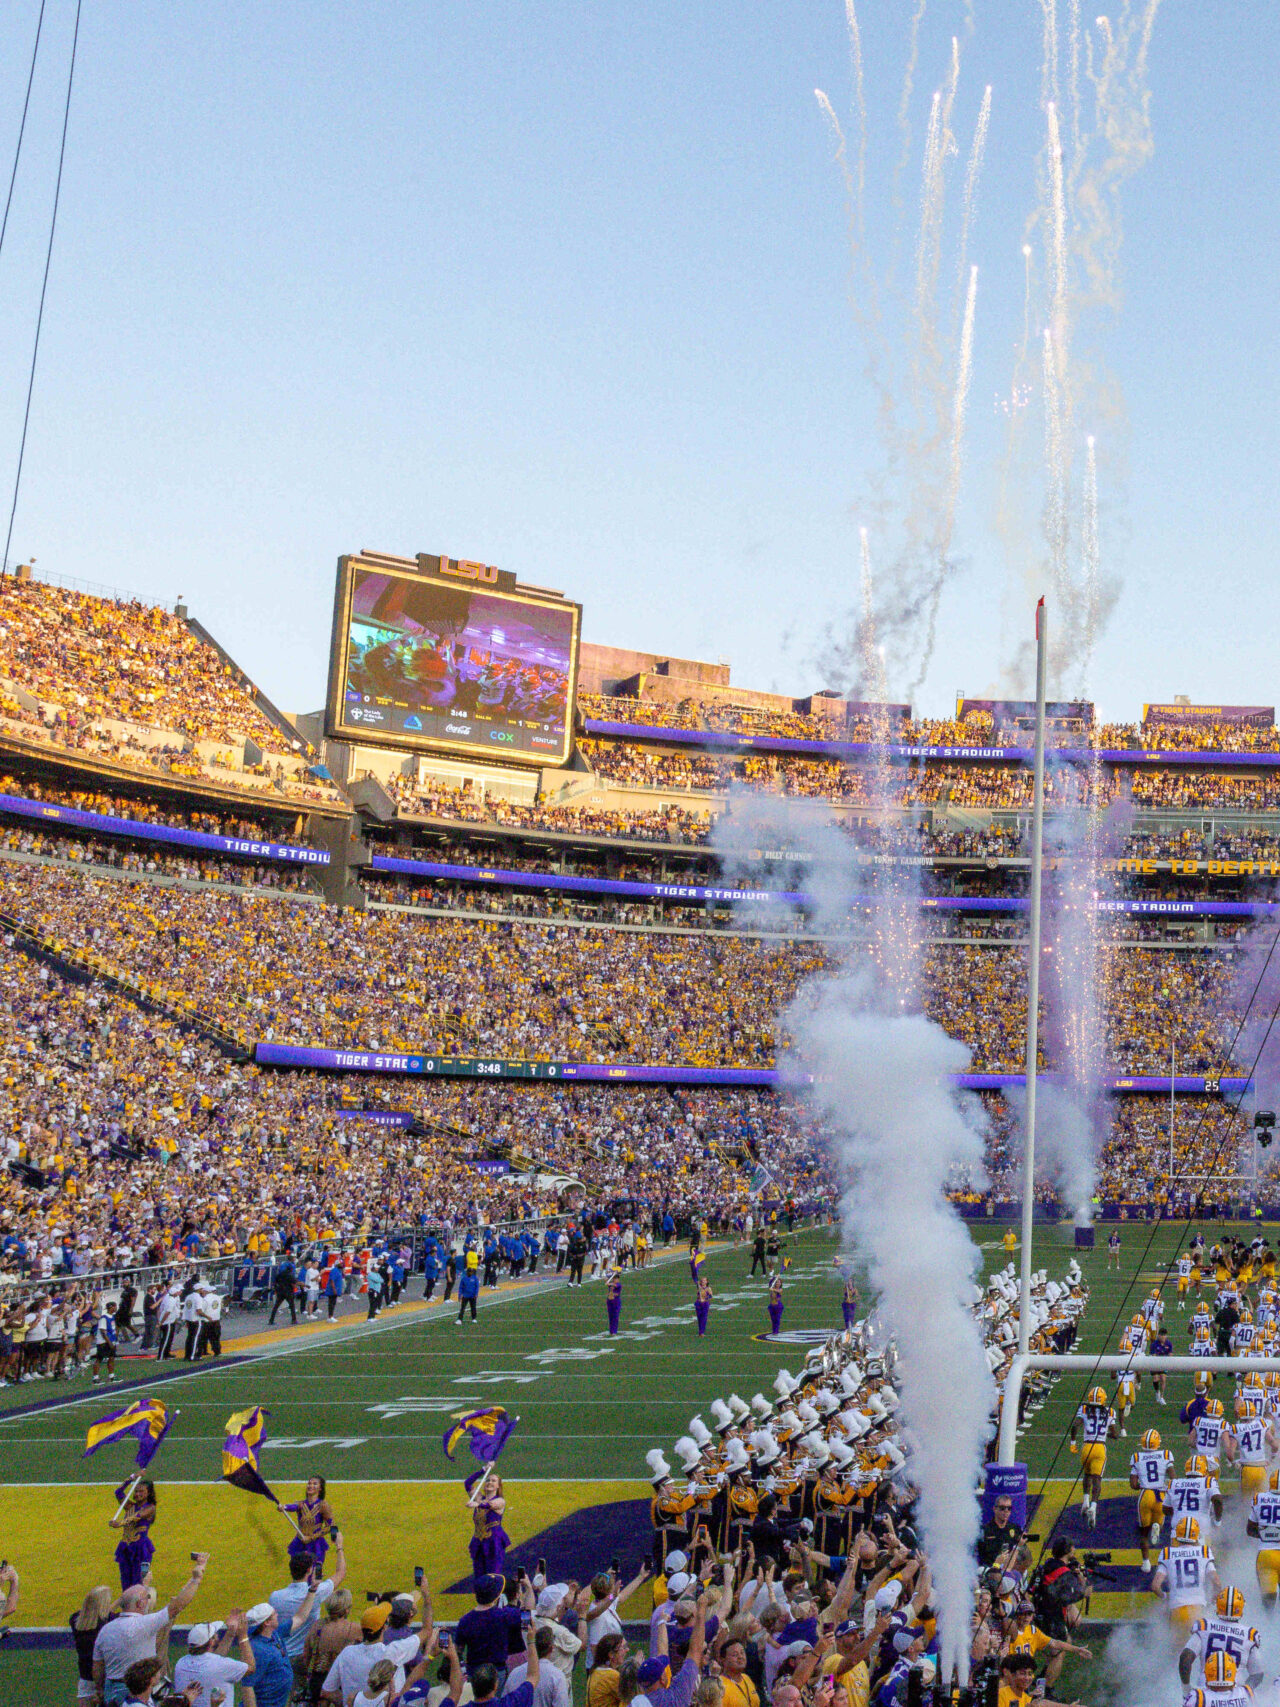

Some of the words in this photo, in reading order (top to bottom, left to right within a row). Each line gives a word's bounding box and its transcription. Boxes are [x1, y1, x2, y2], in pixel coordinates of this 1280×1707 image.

[439, 555, 498, 583] LSU
[1159, 706, 1183, 714] TIGER
[489, 730, 514, 742] COX
[532, 736, 558, 746] VENTURE
[899, 747, 937, 757] TIGER
[944, 749, 1004, 758] STADIUM
[43, 808, 60, 818] LSU
[225, 840, 270, 856] TIGER
[278, 848, 330, 864] STADIU
[765, 850, 782, 859] BILLY
[874, 855, 897, 865] TOMMY
[1169, 859, 1200, 874] TO
[655, 886, 696, 897] TIGER
[704, 888, 769, 900] STADIUM
[1092, 902, 1125, 911] GER
[1131, 903, 1194, 912] STADIUM
[336, 1054, 369, 1067] TIGER
[427, 1060, 434, 1071] 0
[477, 1062, 501, 1074] 3:48
[531, 1067, 536, 1075] 1
[548, 1066, 556, 1076] 0
[609, 1069, 627, 1077] LSU
[1116, 1079, 1133, 1087] LSU
[1205, 1080, 1219, 1091] 25
[1181, 1264, 1187, 1274] 6
[1238, 1328, 1252, 1342] 40
[1086, 1414, 1107, 1436] 32
[1198, 1427, 1218, 1448] 39
[1241, 1429, 1261, 1452] 47
[1142, 1452, 1162, 1460] JOHNSON
[1145, 1460, 1159, 1483] 8
[1003, 1480, 1020, 1488] Energy
[1174, 1488, 1199, 1511] 76
[1175, 1558, 1200, 1588] 19
[1210, 1623, 1245, 1637] MUBENGA
